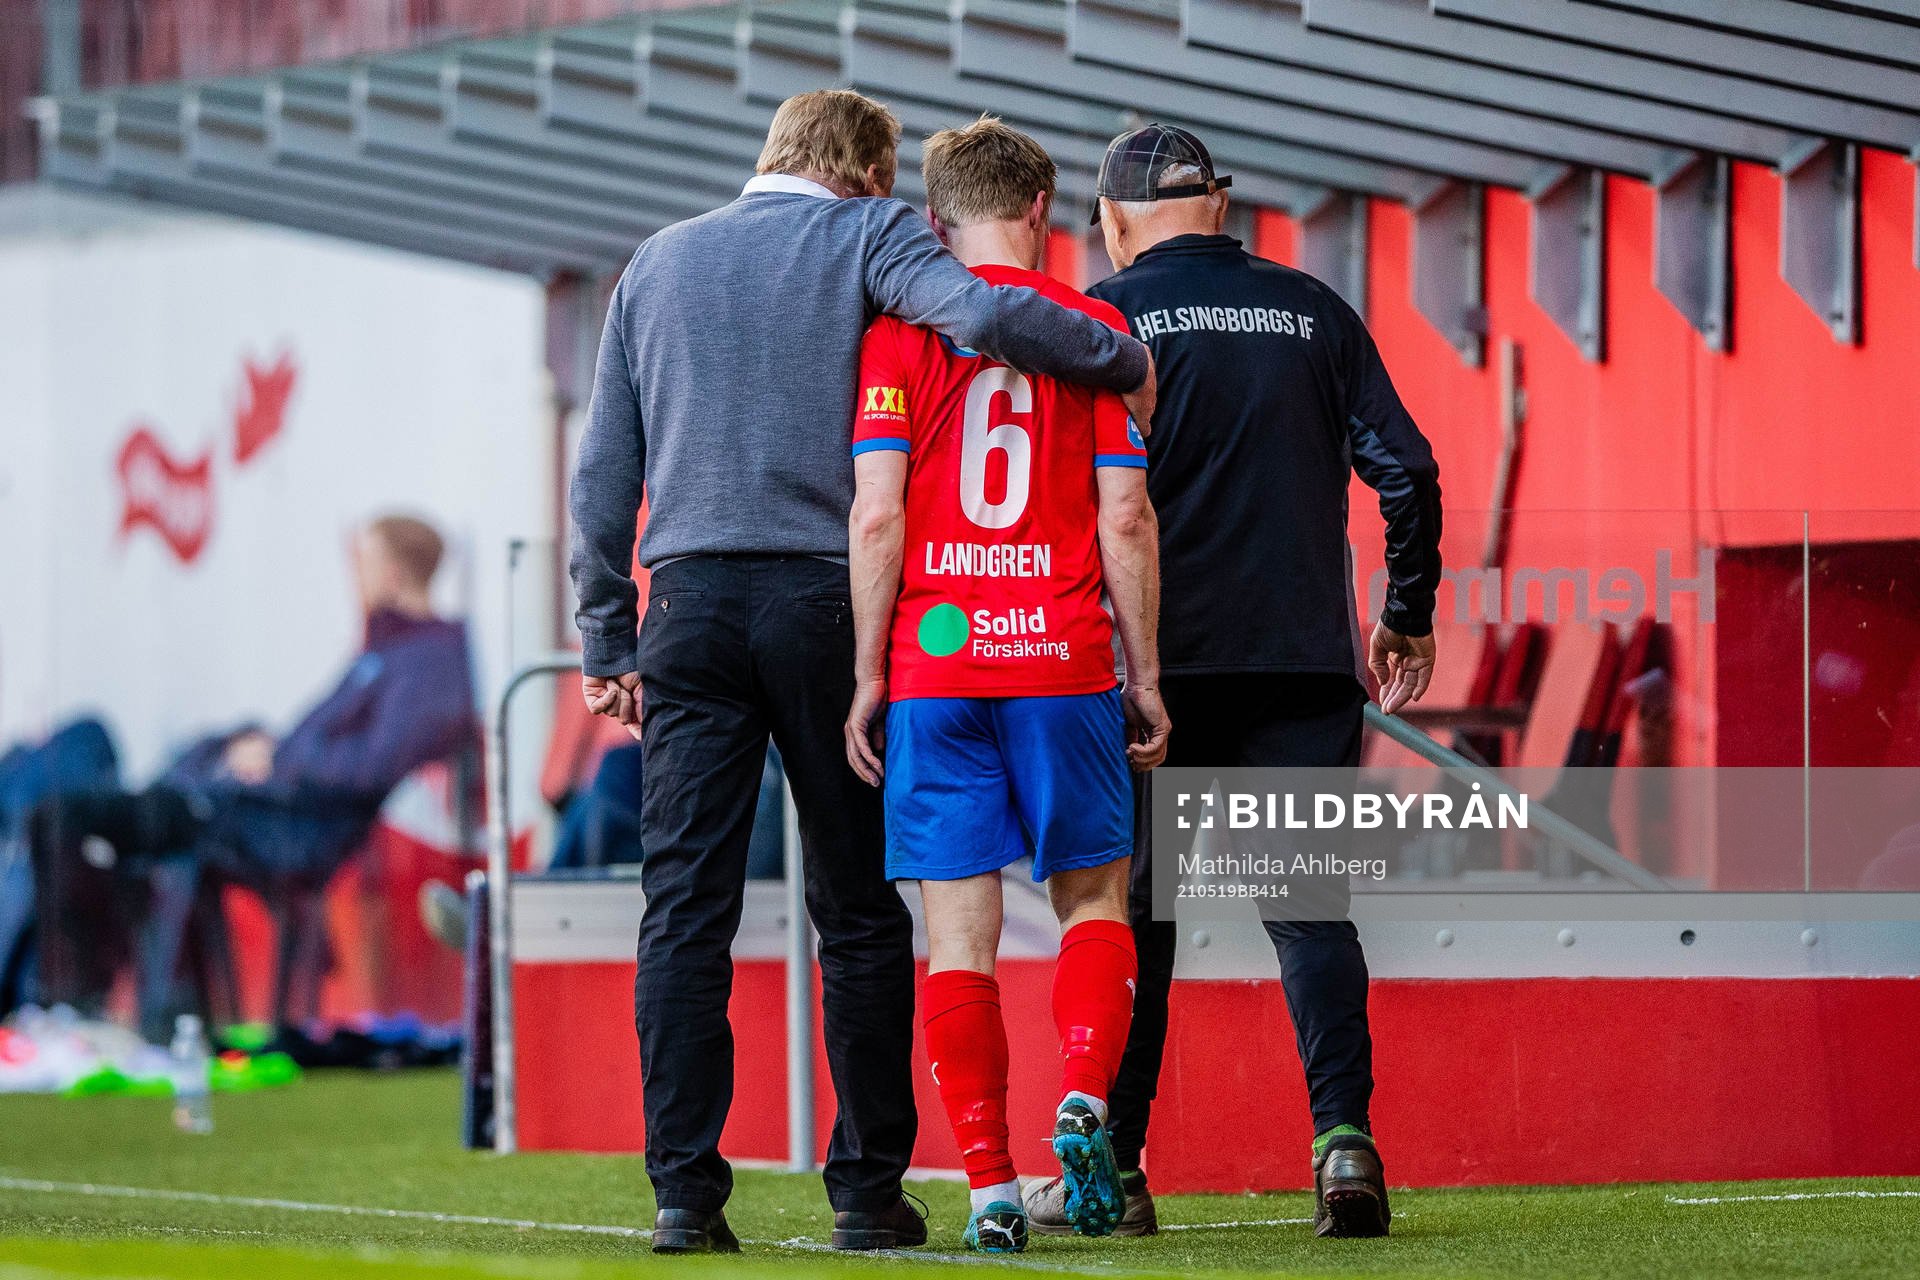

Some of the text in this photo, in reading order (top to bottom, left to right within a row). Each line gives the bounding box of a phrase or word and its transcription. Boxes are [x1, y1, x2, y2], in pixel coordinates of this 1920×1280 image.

[1135, 306, 1315, 342] HELSINGBORGS IF
[863, 386, 906, 414] XXL
[960, 366, 1033, 529] 6
[925, 541, 1051, 578] LANDGREN
[973, 605, 1047, 636] Solid
[972, 637, 1071, 661] Försäkring
